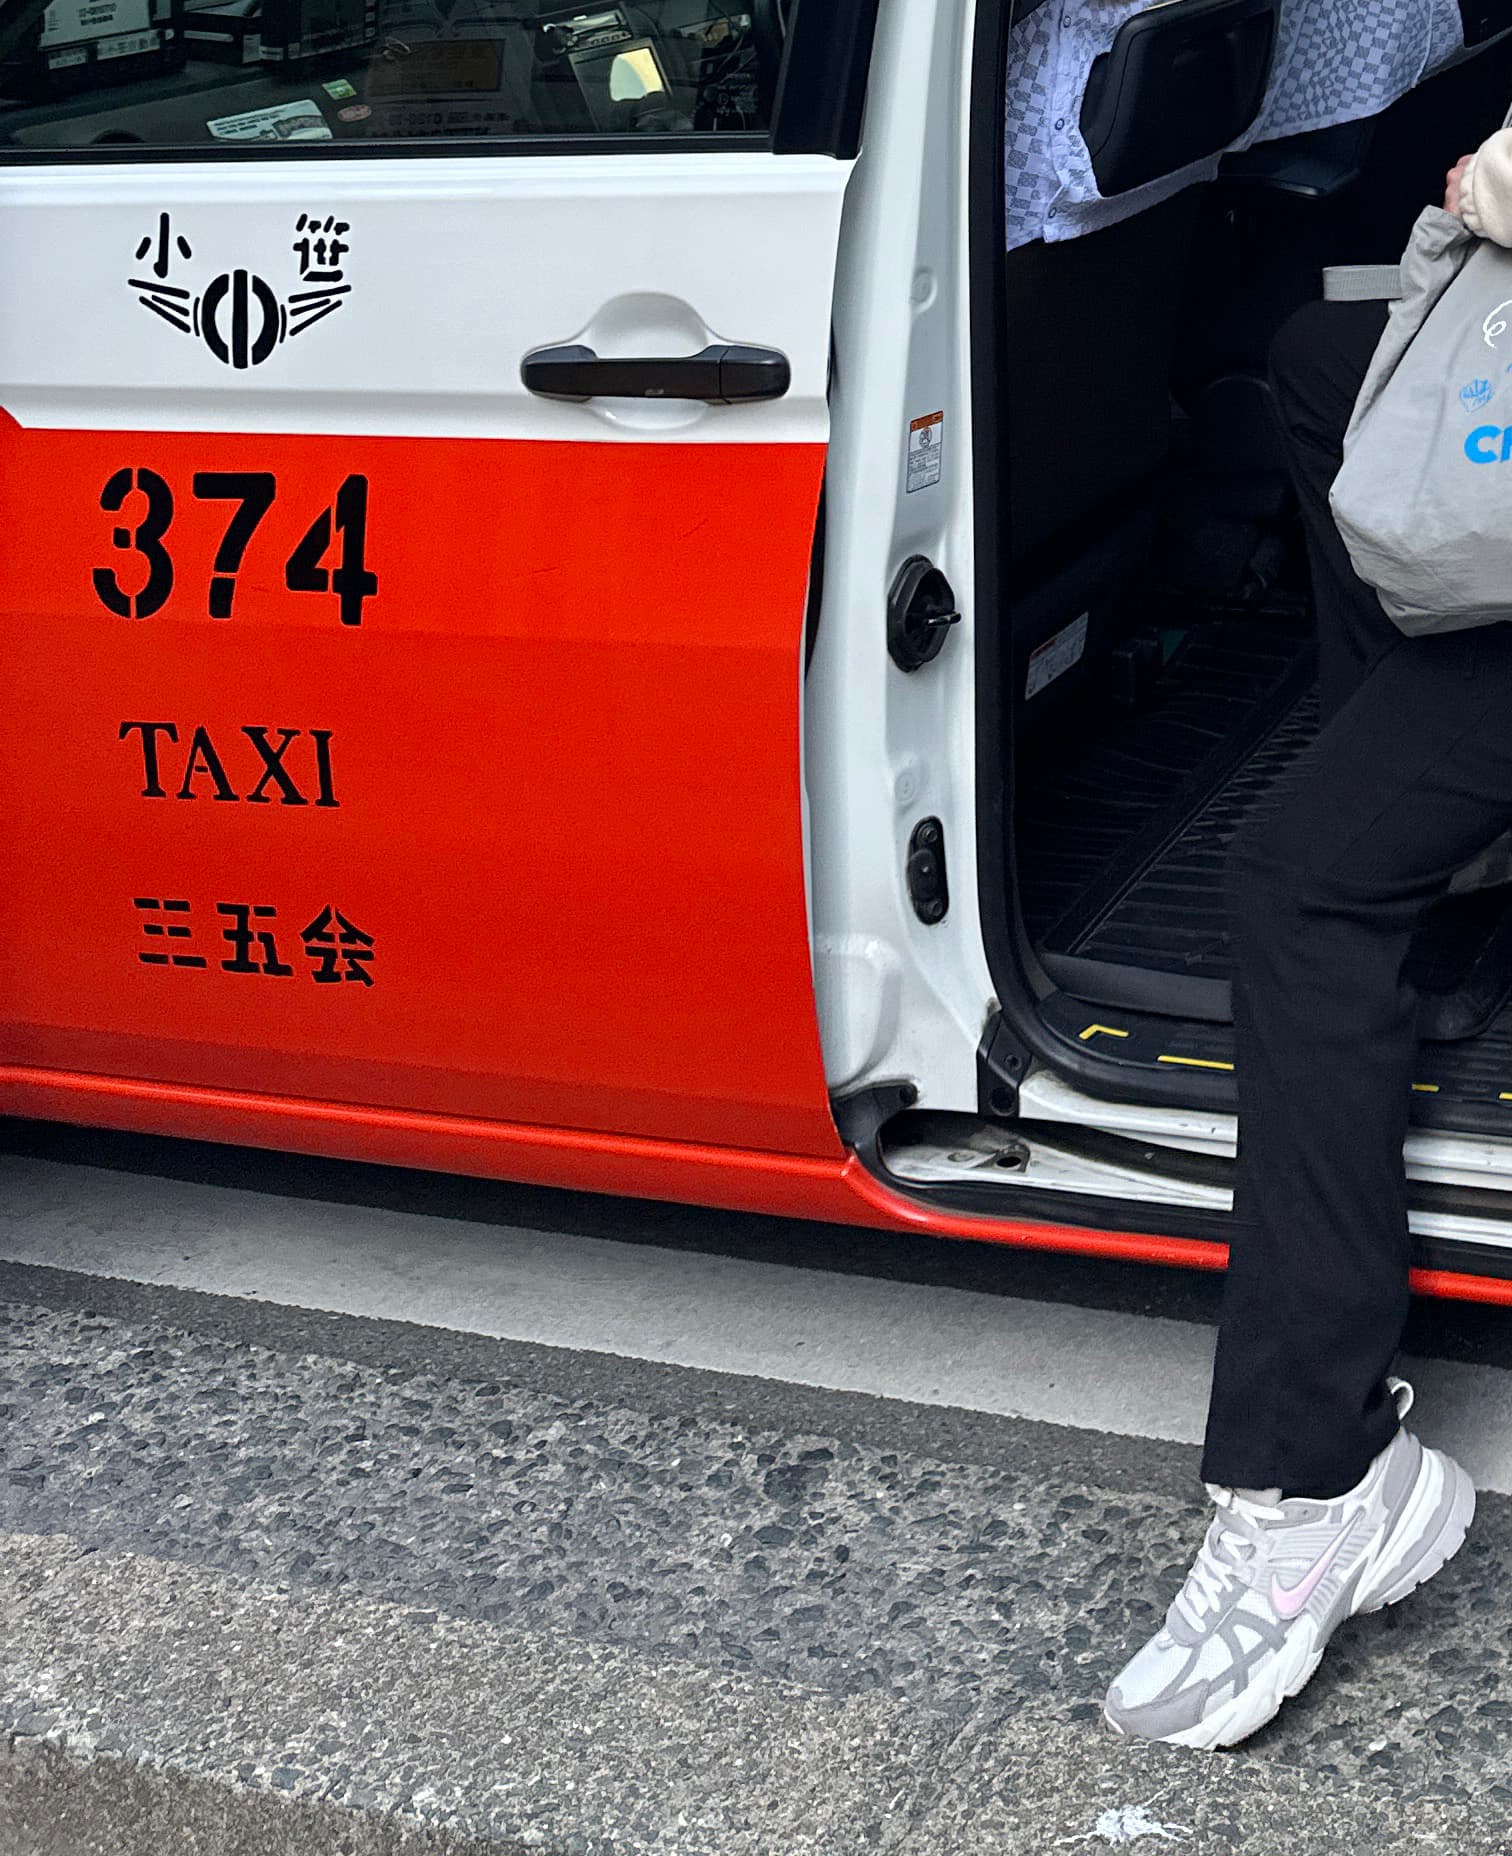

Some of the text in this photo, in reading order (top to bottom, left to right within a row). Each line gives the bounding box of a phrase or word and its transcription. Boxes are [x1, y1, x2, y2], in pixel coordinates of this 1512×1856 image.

[92, 467, 379, 627] 374
[118, 720, 341, 807] TAXI
[133, 897, 376, 987] 三五会
